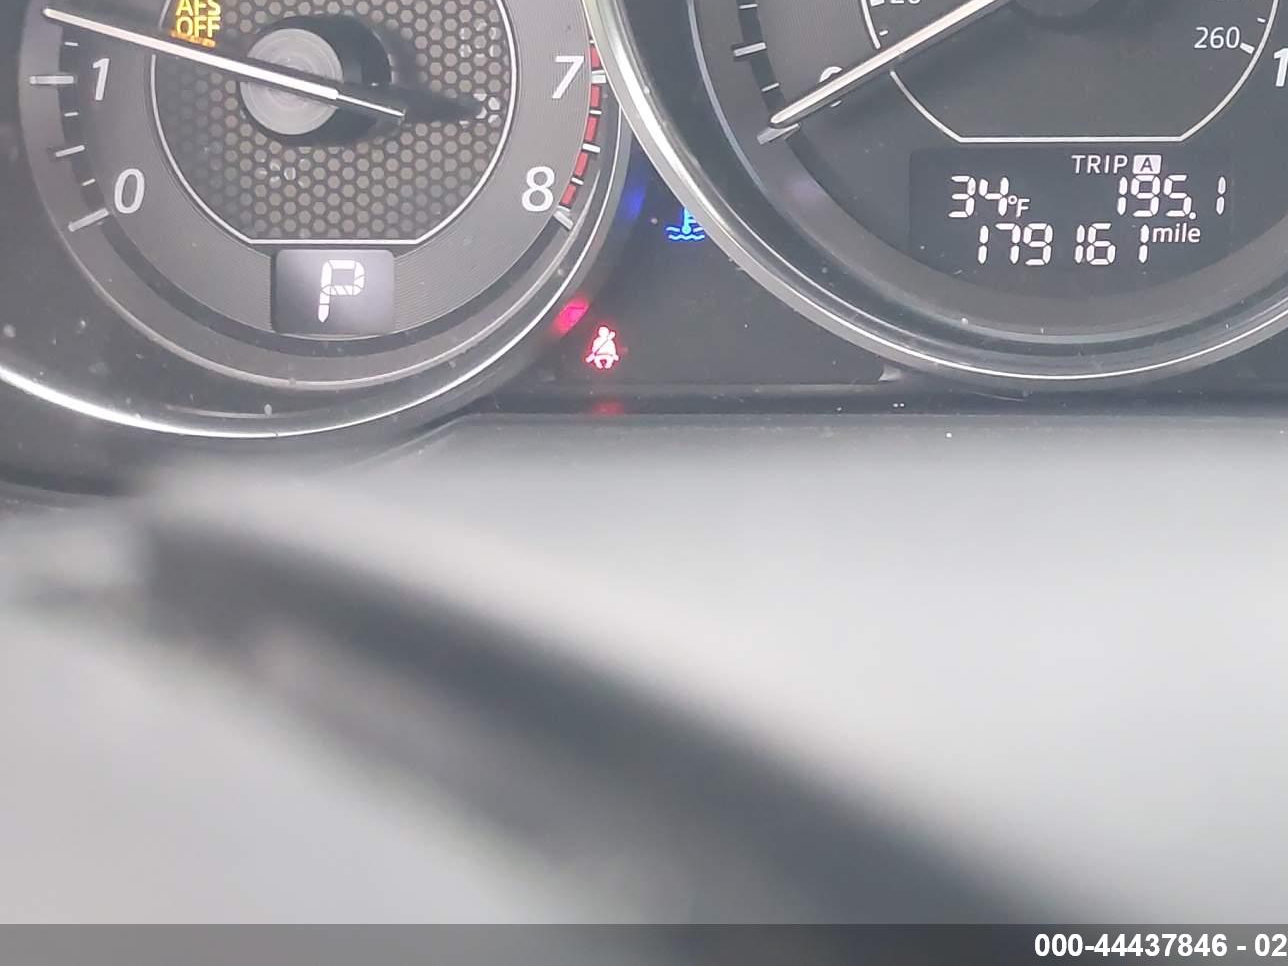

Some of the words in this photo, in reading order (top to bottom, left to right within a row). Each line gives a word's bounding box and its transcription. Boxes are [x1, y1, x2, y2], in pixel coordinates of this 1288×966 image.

[176, 16, 221, 38] OFF
[1194, 26, 1241, 50] 260
[92, 57, 110, 101] 1
[551, 55, 585, 99] 7
[1071, 154, 1128, 174] TRIP
[113, 167, 145, 216] 0
[521, 165, 555, 213] 8
[1116, 174, 1226, 220] 195.1
[1152, 222, 1201, 243] mile
[318, 259, 366, 323] P
